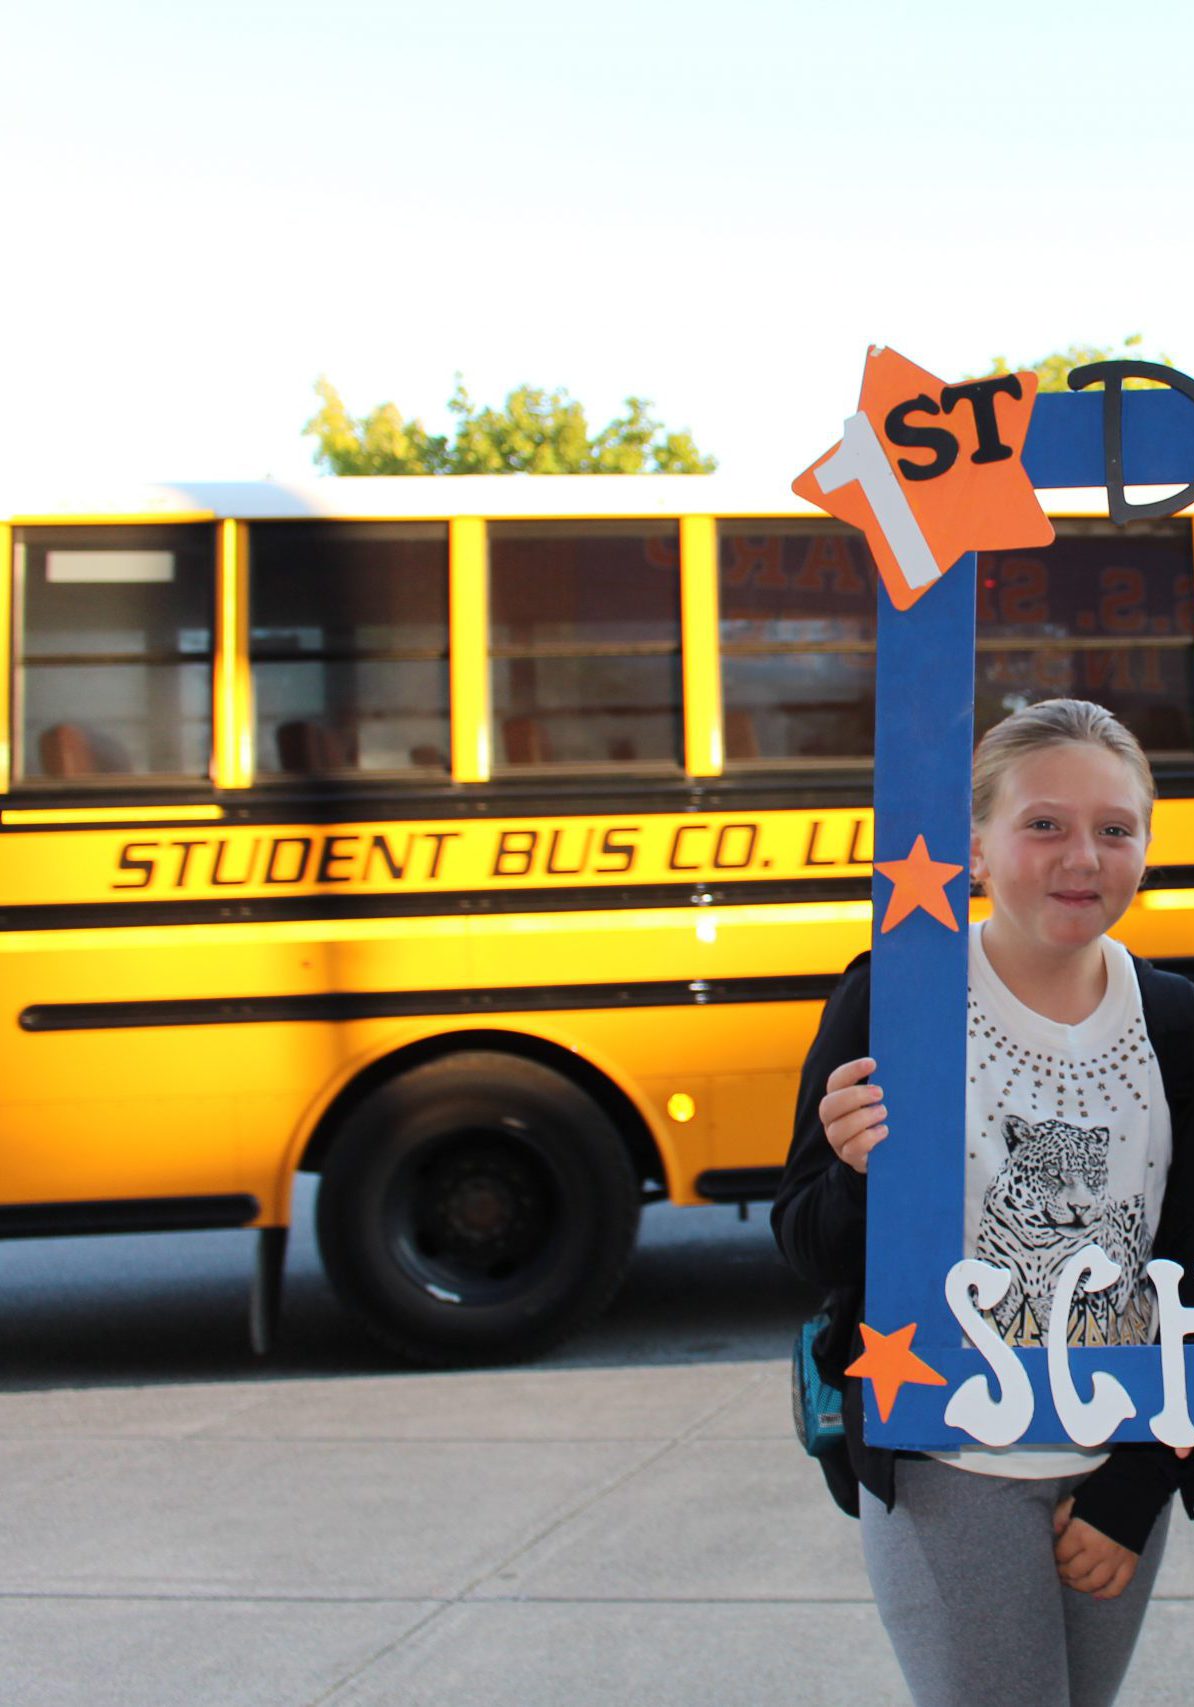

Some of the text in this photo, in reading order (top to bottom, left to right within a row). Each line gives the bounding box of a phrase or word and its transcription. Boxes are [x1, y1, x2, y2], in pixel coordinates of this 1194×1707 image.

[112, 819, 873, 889] STUDENT BUS CO. LL
